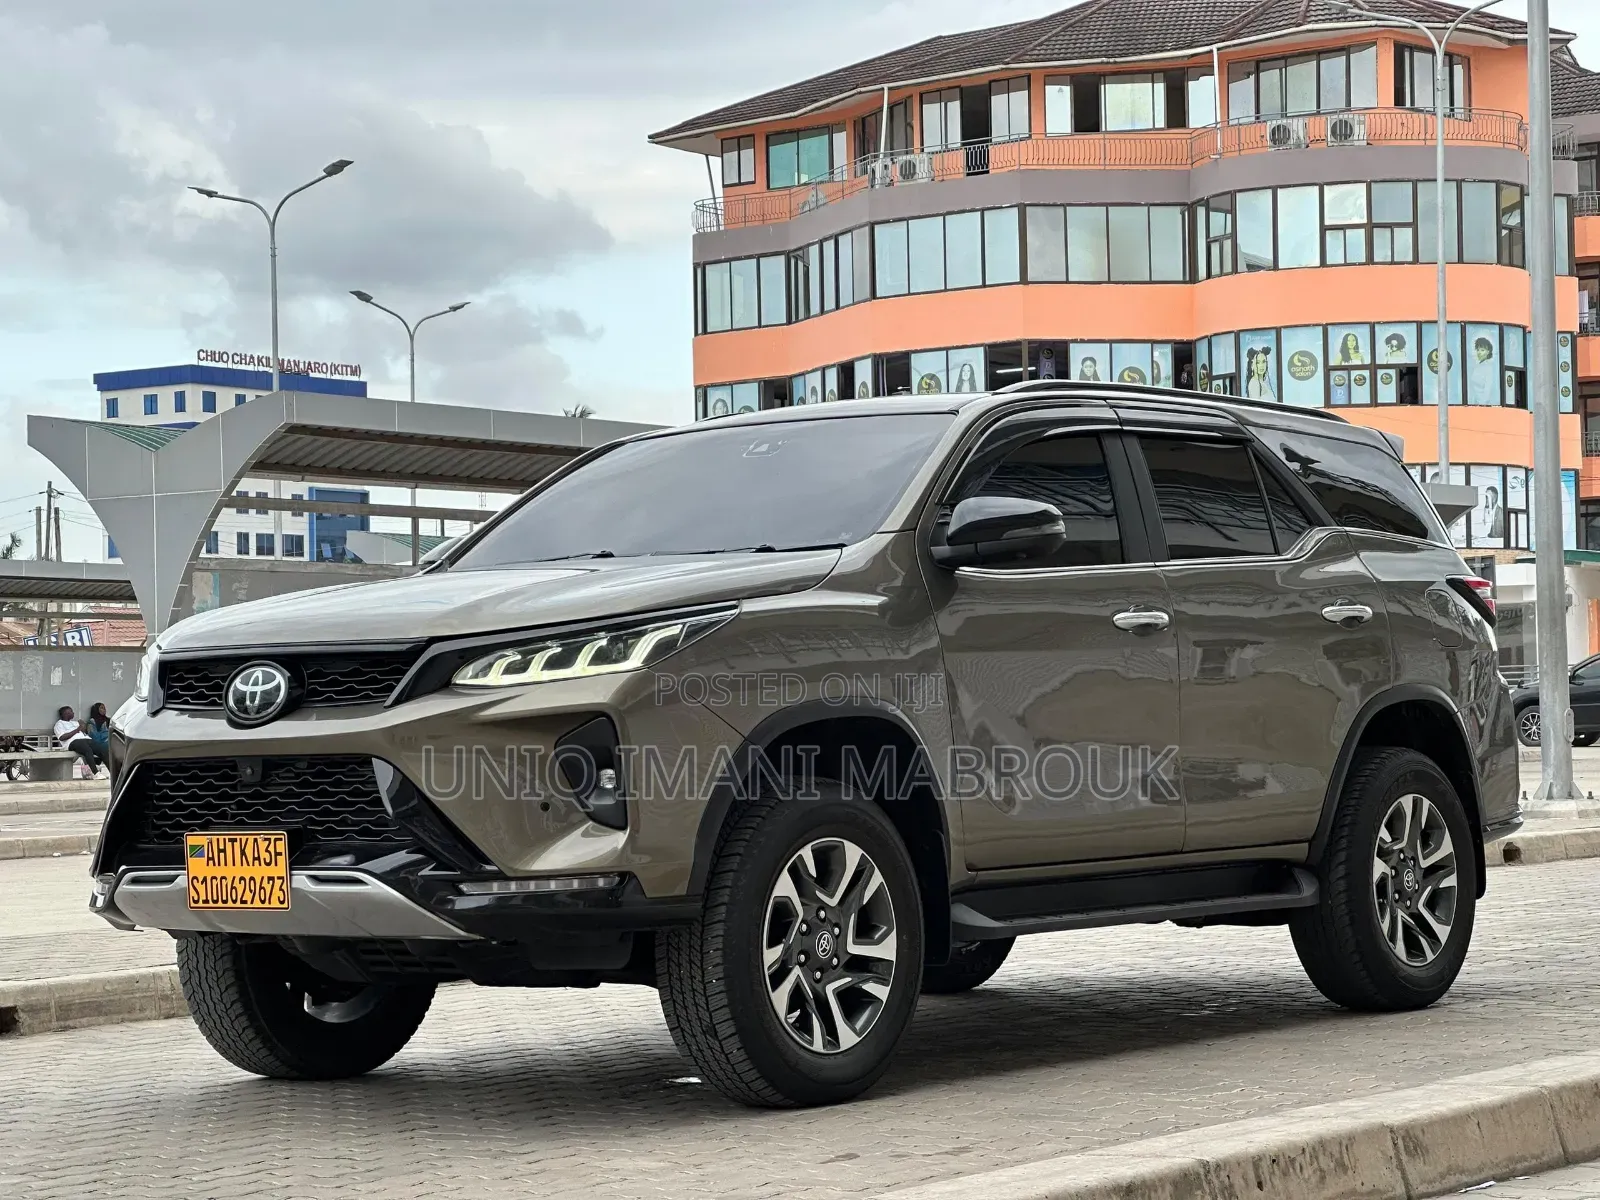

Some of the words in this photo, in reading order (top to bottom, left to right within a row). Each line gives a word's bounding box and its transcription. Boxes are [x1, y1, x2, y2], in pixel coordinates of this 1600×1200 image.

[197, 349, 230, 363] CHUO
[231, 352, 256, 367] CHA
[256, 355, 329, 375] KILMANJARO
[329, 361, 362, 377] (KITM)
[206, 837, 283, 867] AHTKA3F
[190, 875, 286, 905] S100629673
